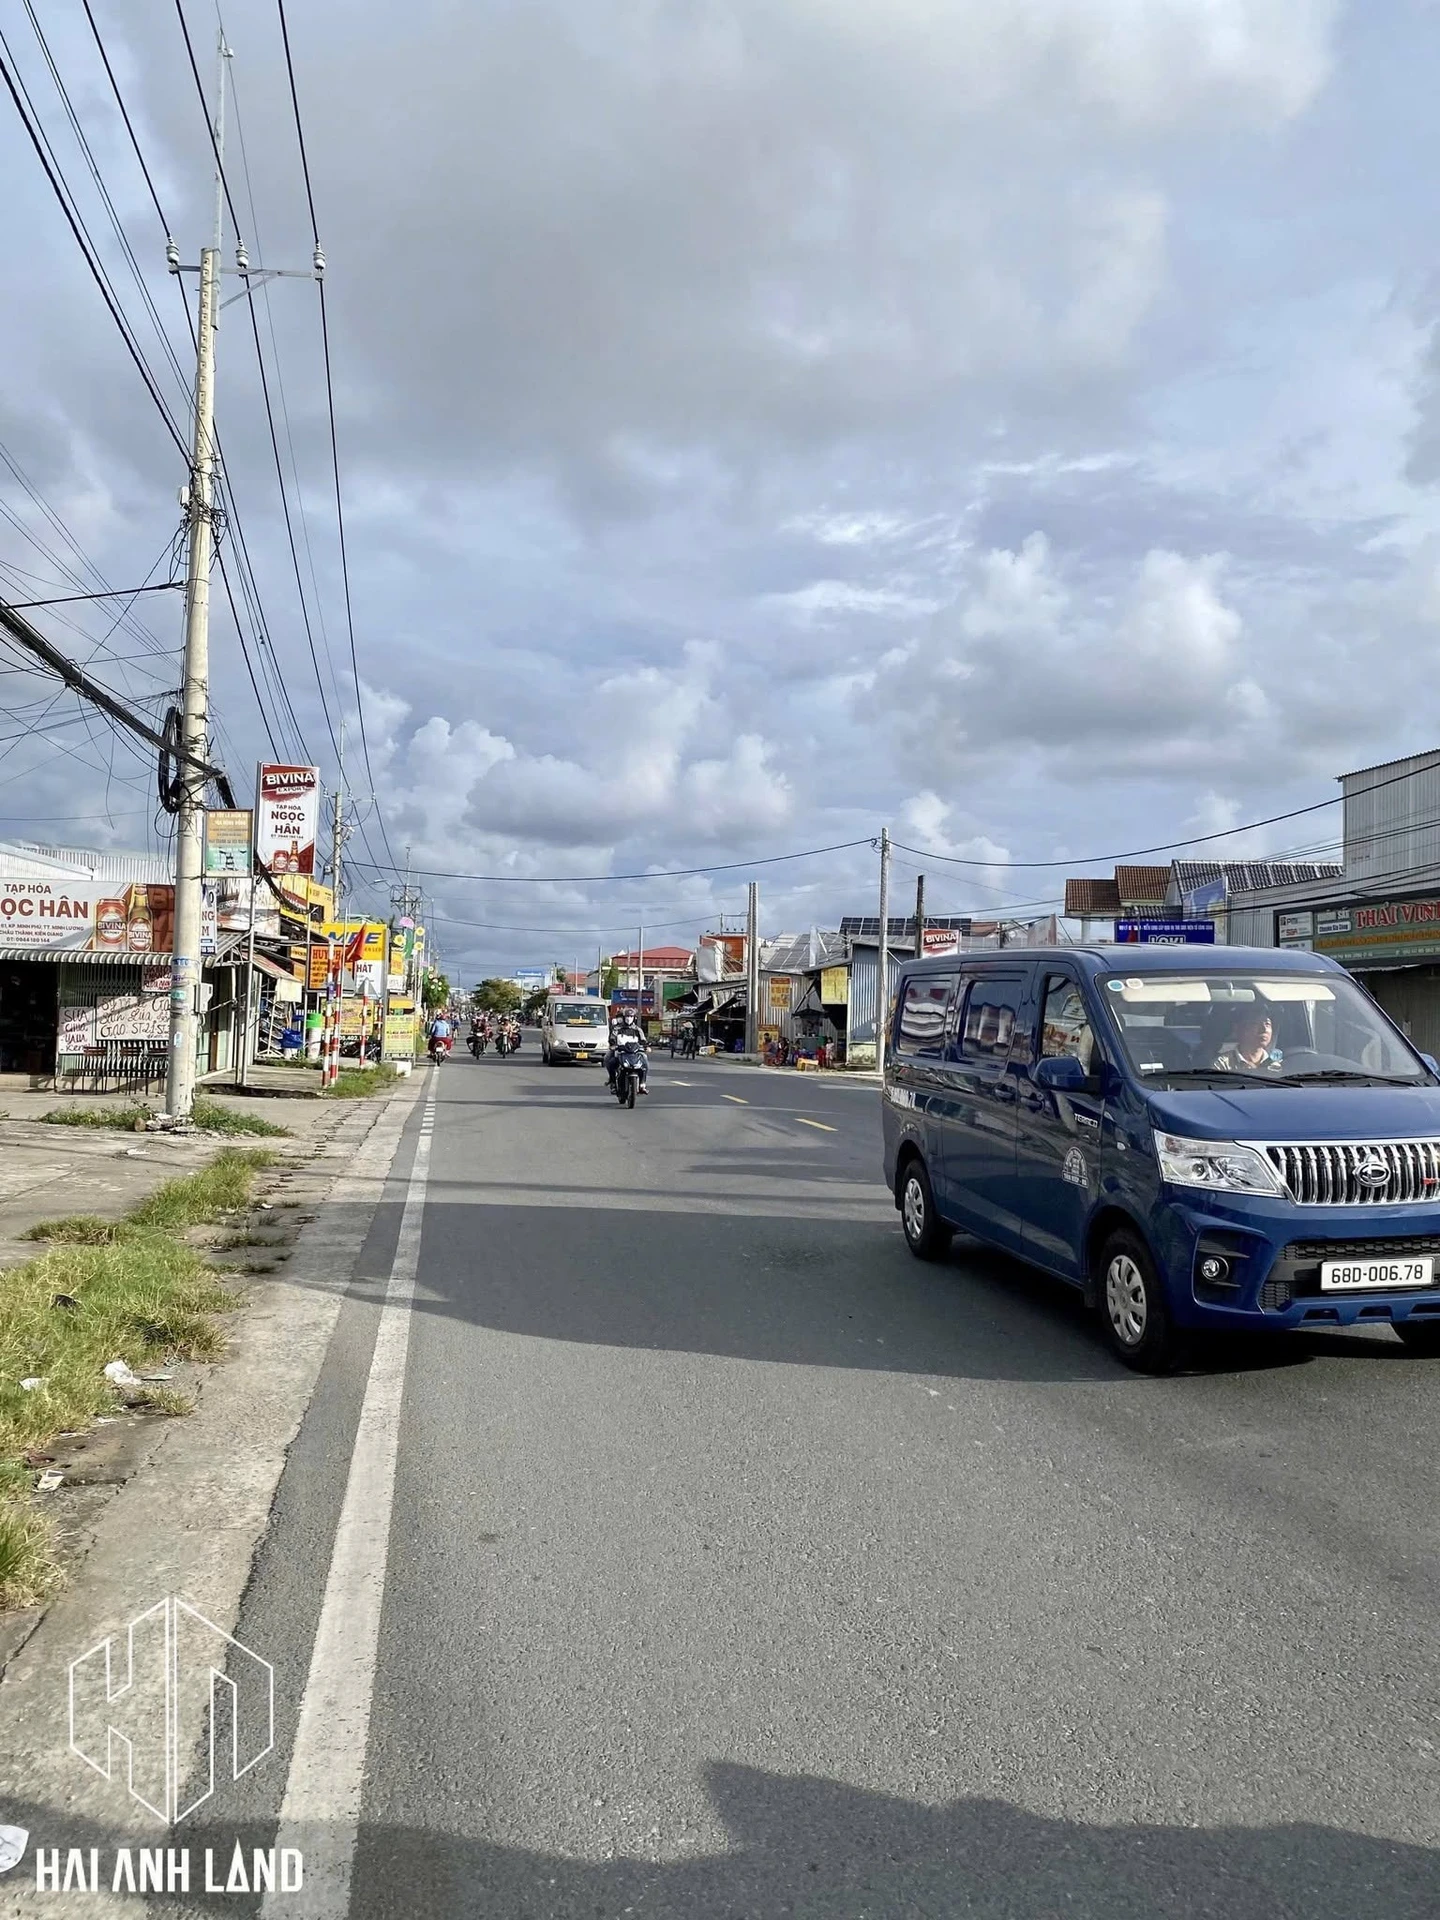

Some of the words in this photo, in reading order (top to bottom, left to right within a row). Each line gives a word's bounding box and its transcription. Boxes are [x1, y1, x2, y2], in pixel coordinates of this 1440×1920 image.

[266, 772, 315, 785] BIVINA
[271, 811, 305, 823] NGỌC
[275, 823, 300, 835] HÂN
[4, 883, 26, 895] TẠP
[39, 895, 88, 918] HÂN
[98, 921, 126, 931] BIVINA
[129, 931, 153, 939] BIVINA
[926, 933, 956, 943] BIVINA
[1331, 1264, 1423, 1284] 68D-006.78
